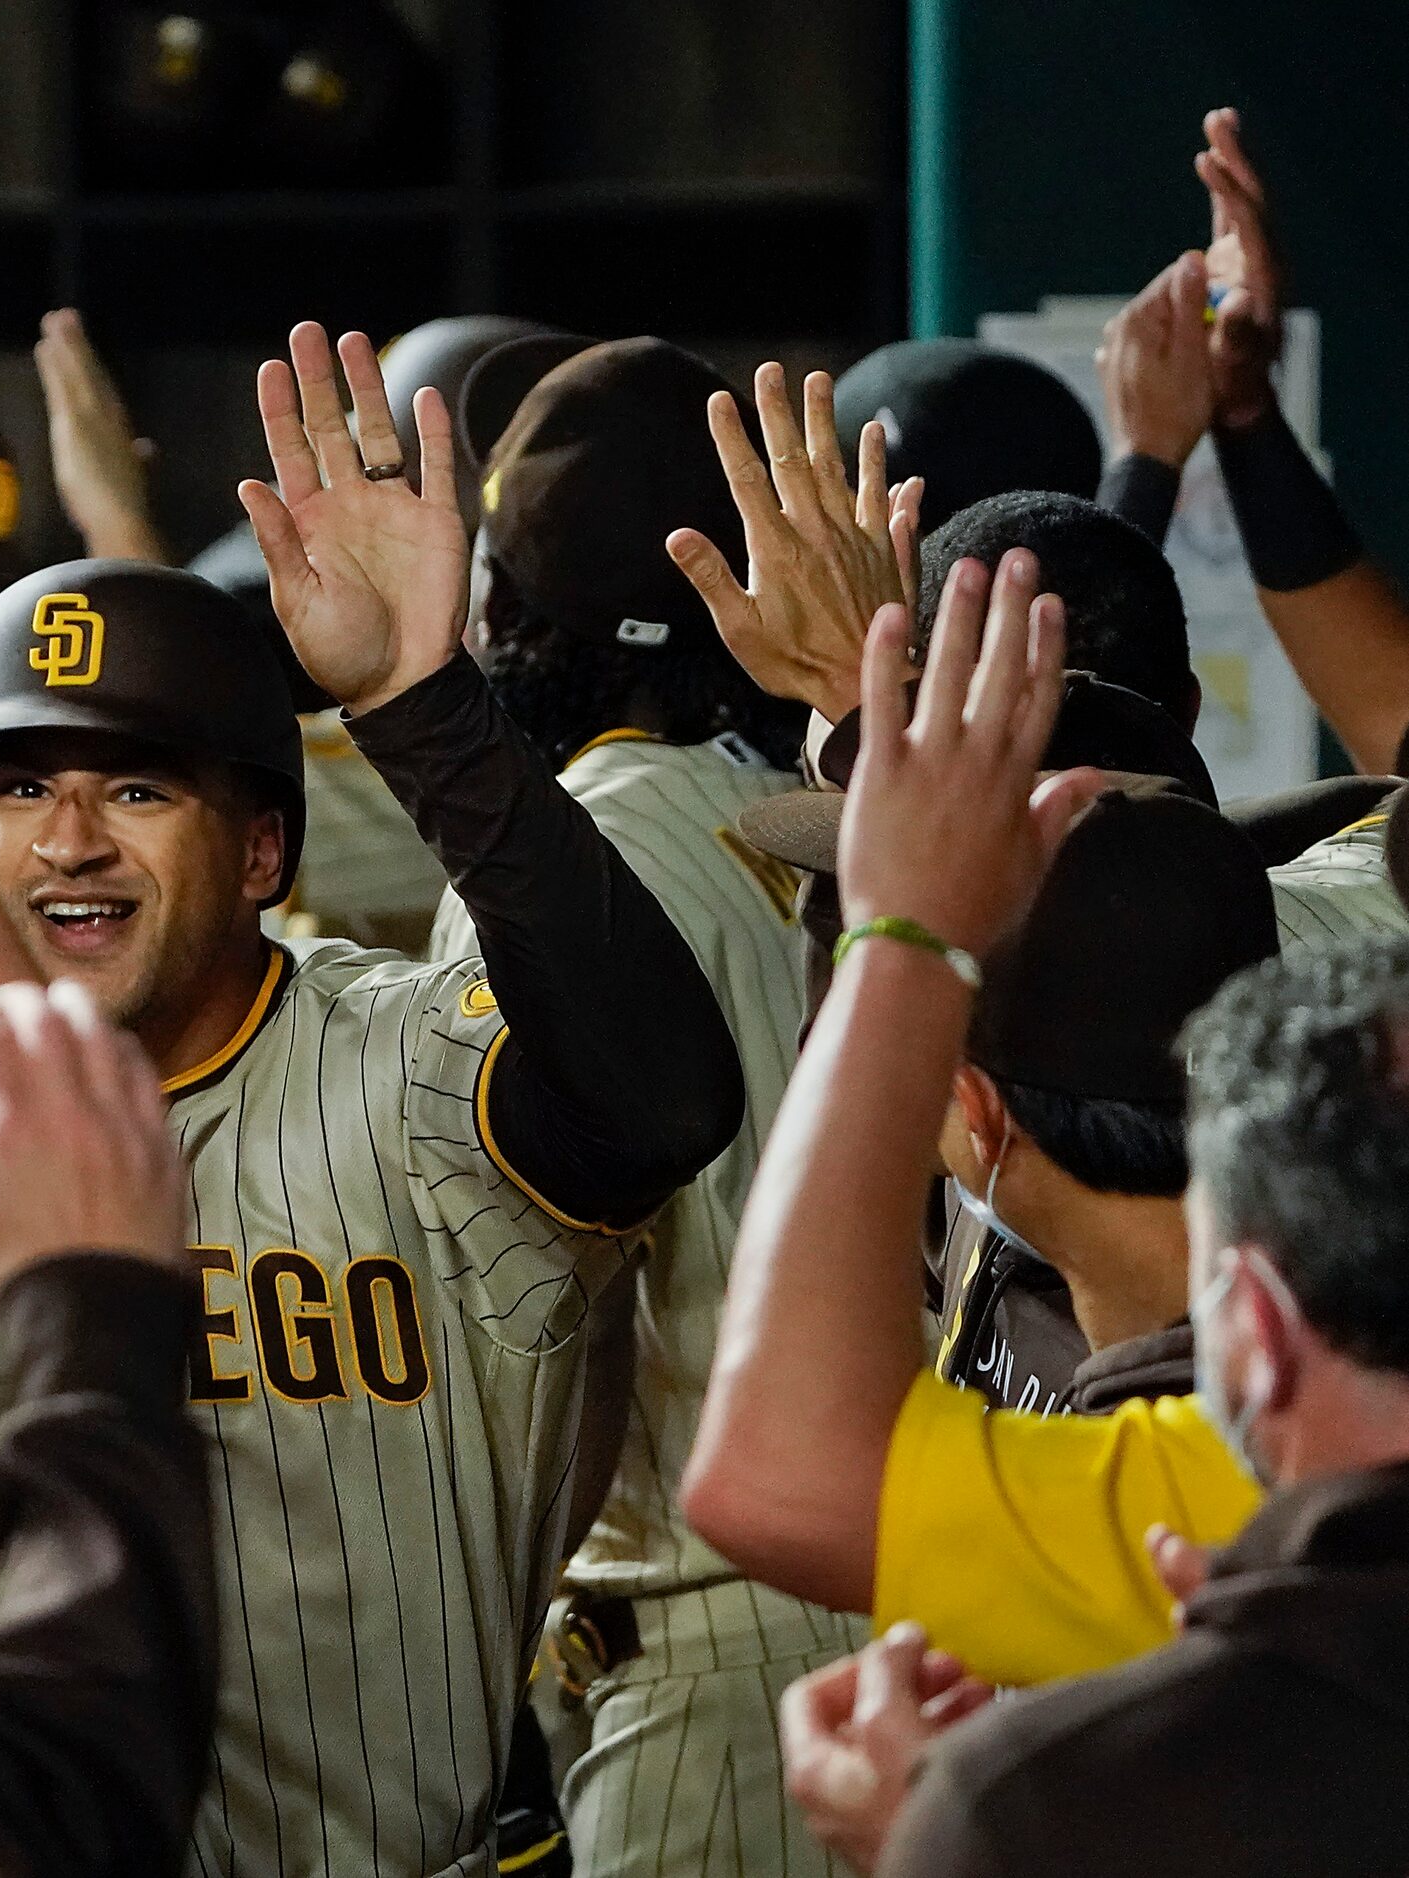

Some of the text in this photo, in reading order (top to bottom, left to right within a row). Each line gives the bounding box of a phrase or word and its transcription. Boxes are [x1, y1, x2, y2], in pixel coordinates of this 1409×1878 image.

[29, 592, 105, 687] SD
[184, 1243, 433, 1407] EGO
[1015, 1373, 1072, 1421] DI
